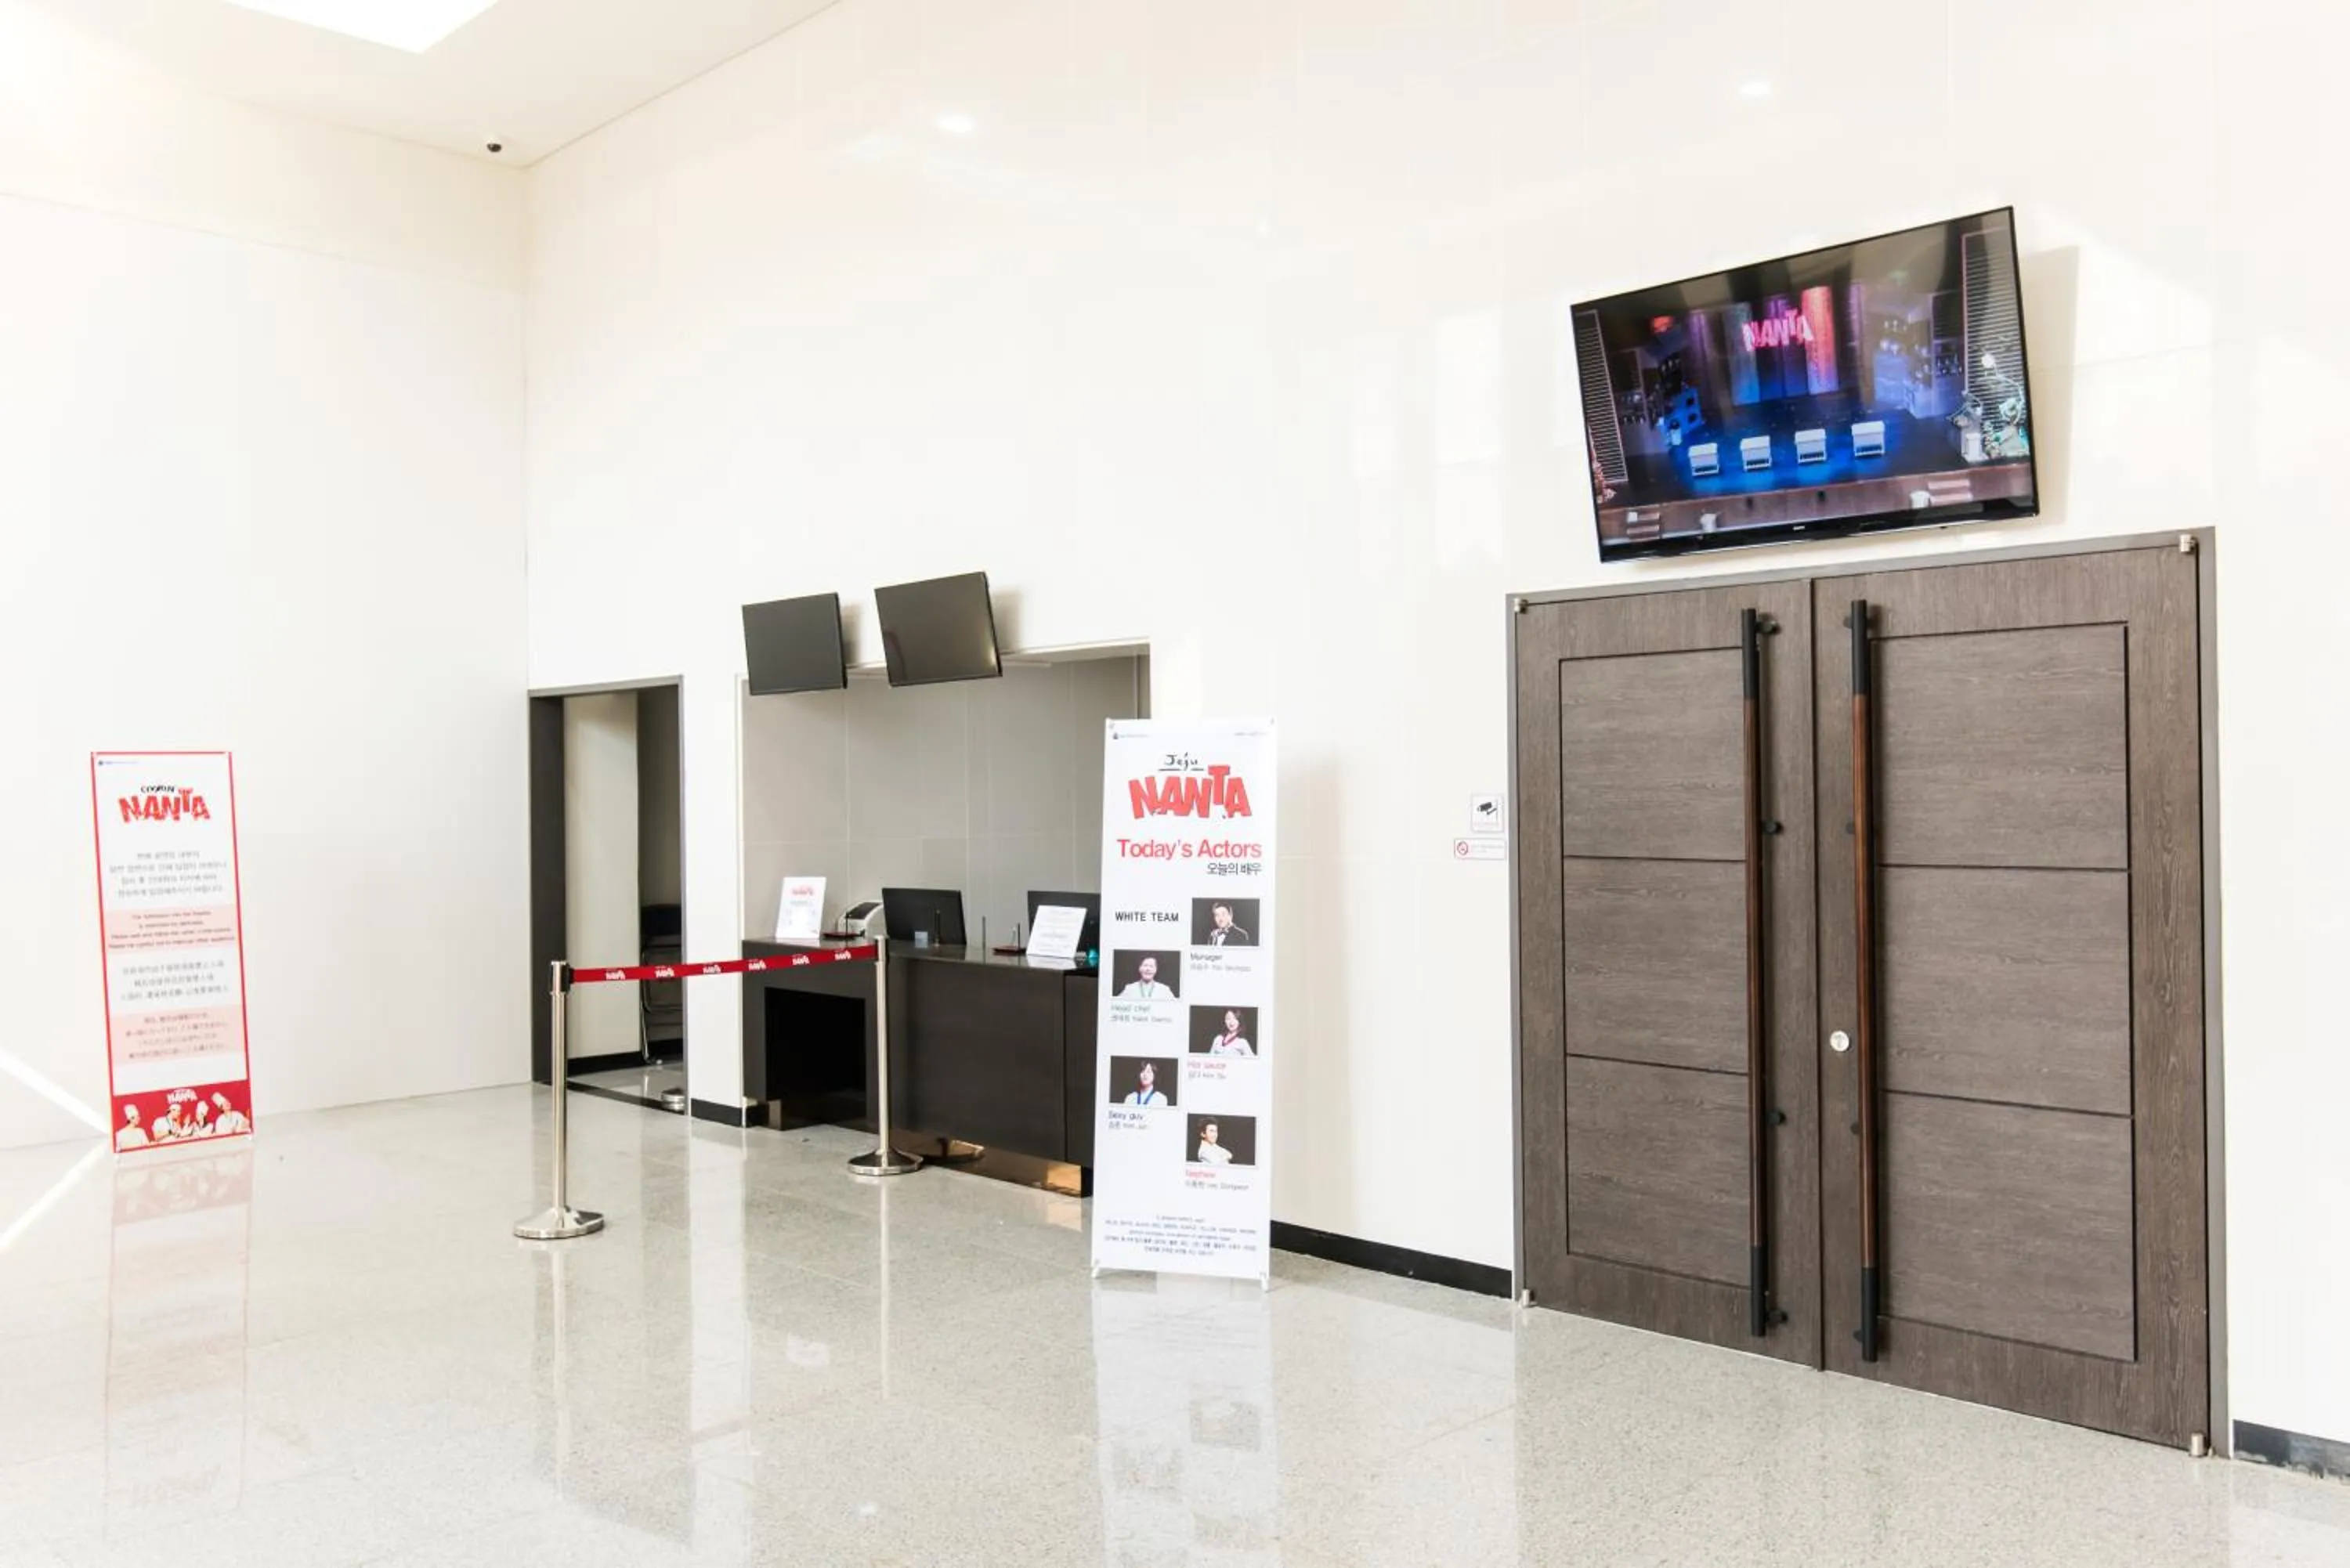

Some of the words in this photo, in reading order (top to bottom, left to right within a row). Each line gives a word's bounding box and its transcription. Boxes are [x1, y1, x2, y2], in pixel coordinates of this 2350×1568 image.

[1742, 309, 1814, 352] NANTA
[1165, 752, 1198, 771] Jeju
[1128, 764, 1252, 819] NANTA
[118, 787, 211, 823] NANTA
[1117, 839, 1193, 860] Today's
[1198, 839, 1262, 858] Actors
[1206, 862, 1238, 876] 오늘의
[1240, 862, 1262, 876] 배우
[1115, 912, 1146, 922] WHITE
[1152, 912, 1179, 922] TEAM
